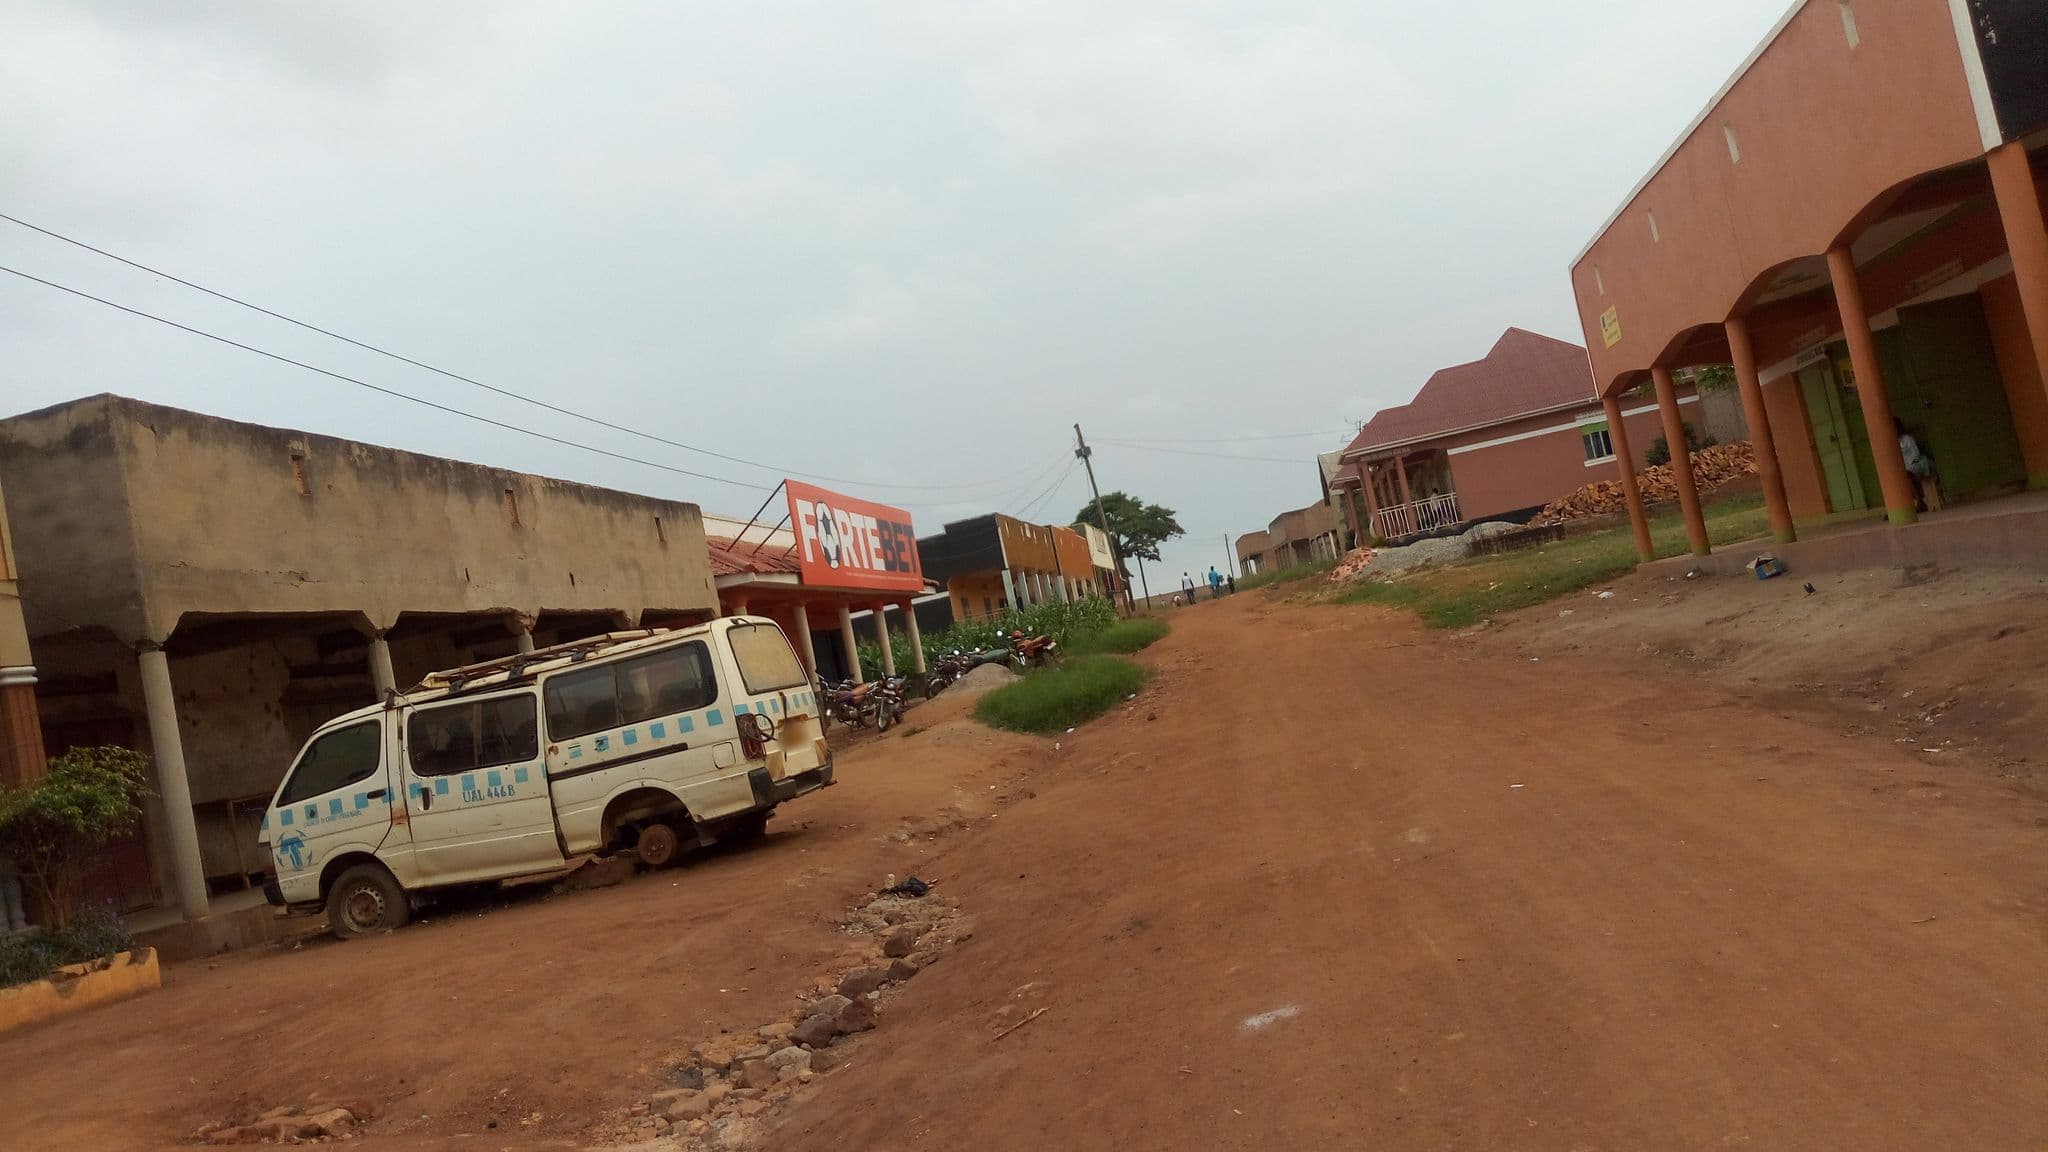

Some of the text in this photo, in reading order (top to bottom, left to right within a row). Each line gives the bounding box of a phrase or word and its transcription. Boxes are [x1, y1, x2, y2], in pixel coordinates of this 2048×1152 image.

[795, 498, 917, 573] FORTEBET
[462, 784, 515, 803] UAL 446B
